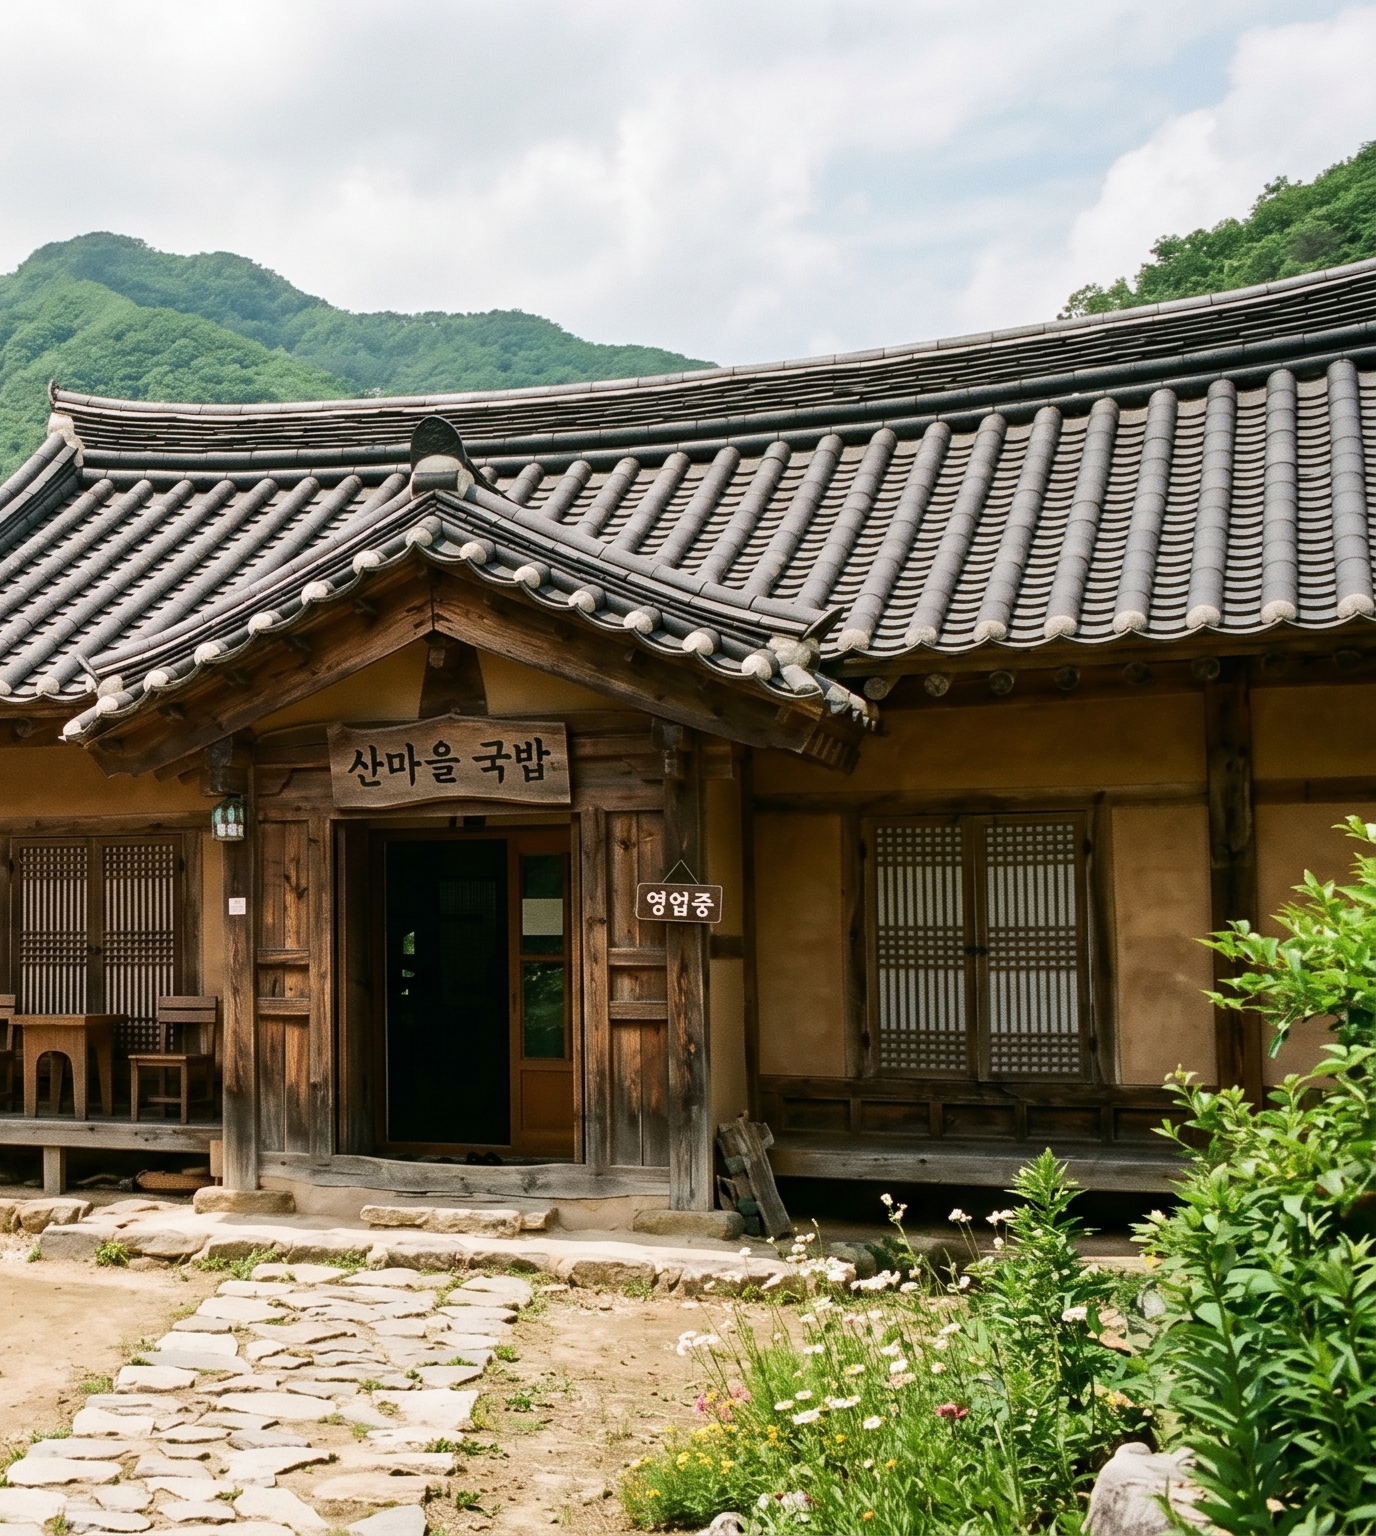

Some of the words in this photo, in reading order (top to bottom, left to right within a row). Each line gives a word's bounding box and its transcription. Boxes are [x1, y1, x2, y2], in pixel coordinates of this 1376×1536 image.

[347, 740, 461, 787] 산마을
[471, 737, 551, 784] 국밥
[646, 890, 715, 918] 영업중
